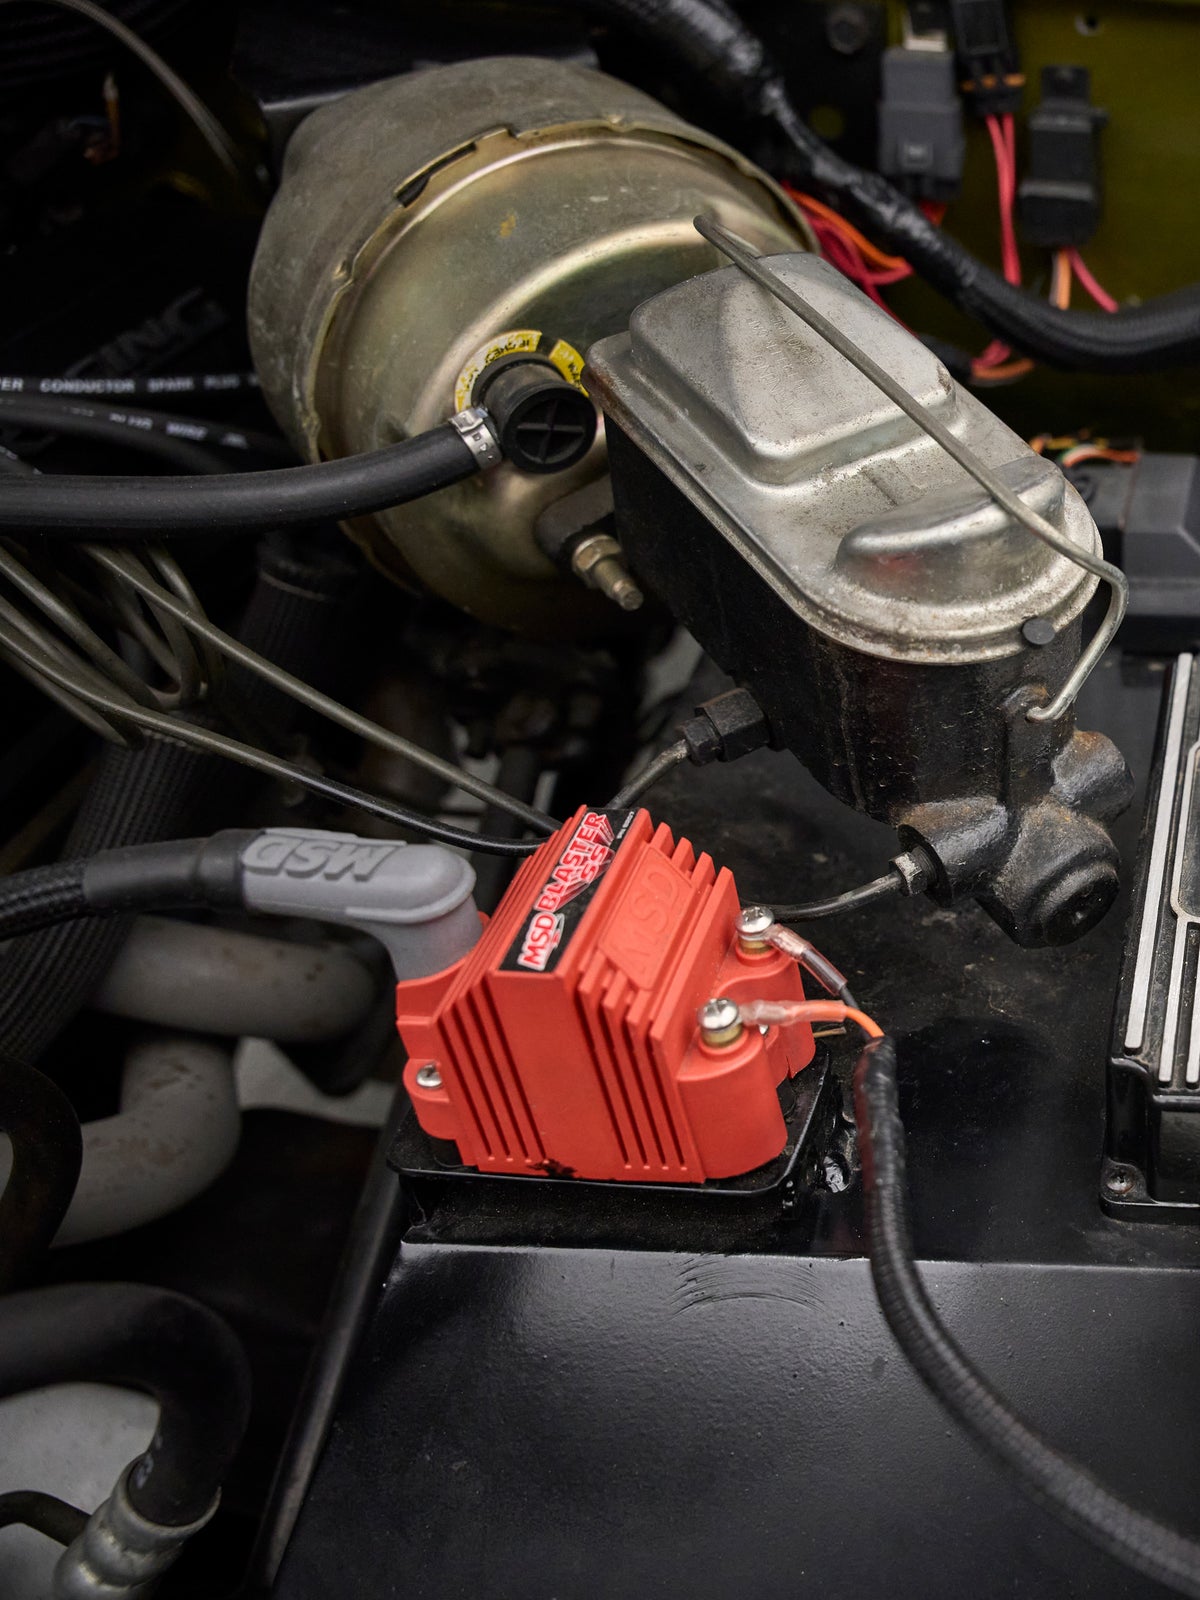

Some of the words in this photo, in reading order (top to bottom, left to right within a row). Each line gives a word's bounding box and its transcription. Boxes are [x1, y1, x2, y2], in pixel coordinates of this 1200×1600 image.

[0, 377, 23, 391] ER
[41, 379, 135, 392] CONDUCTOR
[243, 836, 397, 882] MSD
[534, 812, 606, 912] BLASTER
[580, 846, 610, 884] SS
[519, 912, 557, 970] MSD
[609, 866, 680, 976] MSD
